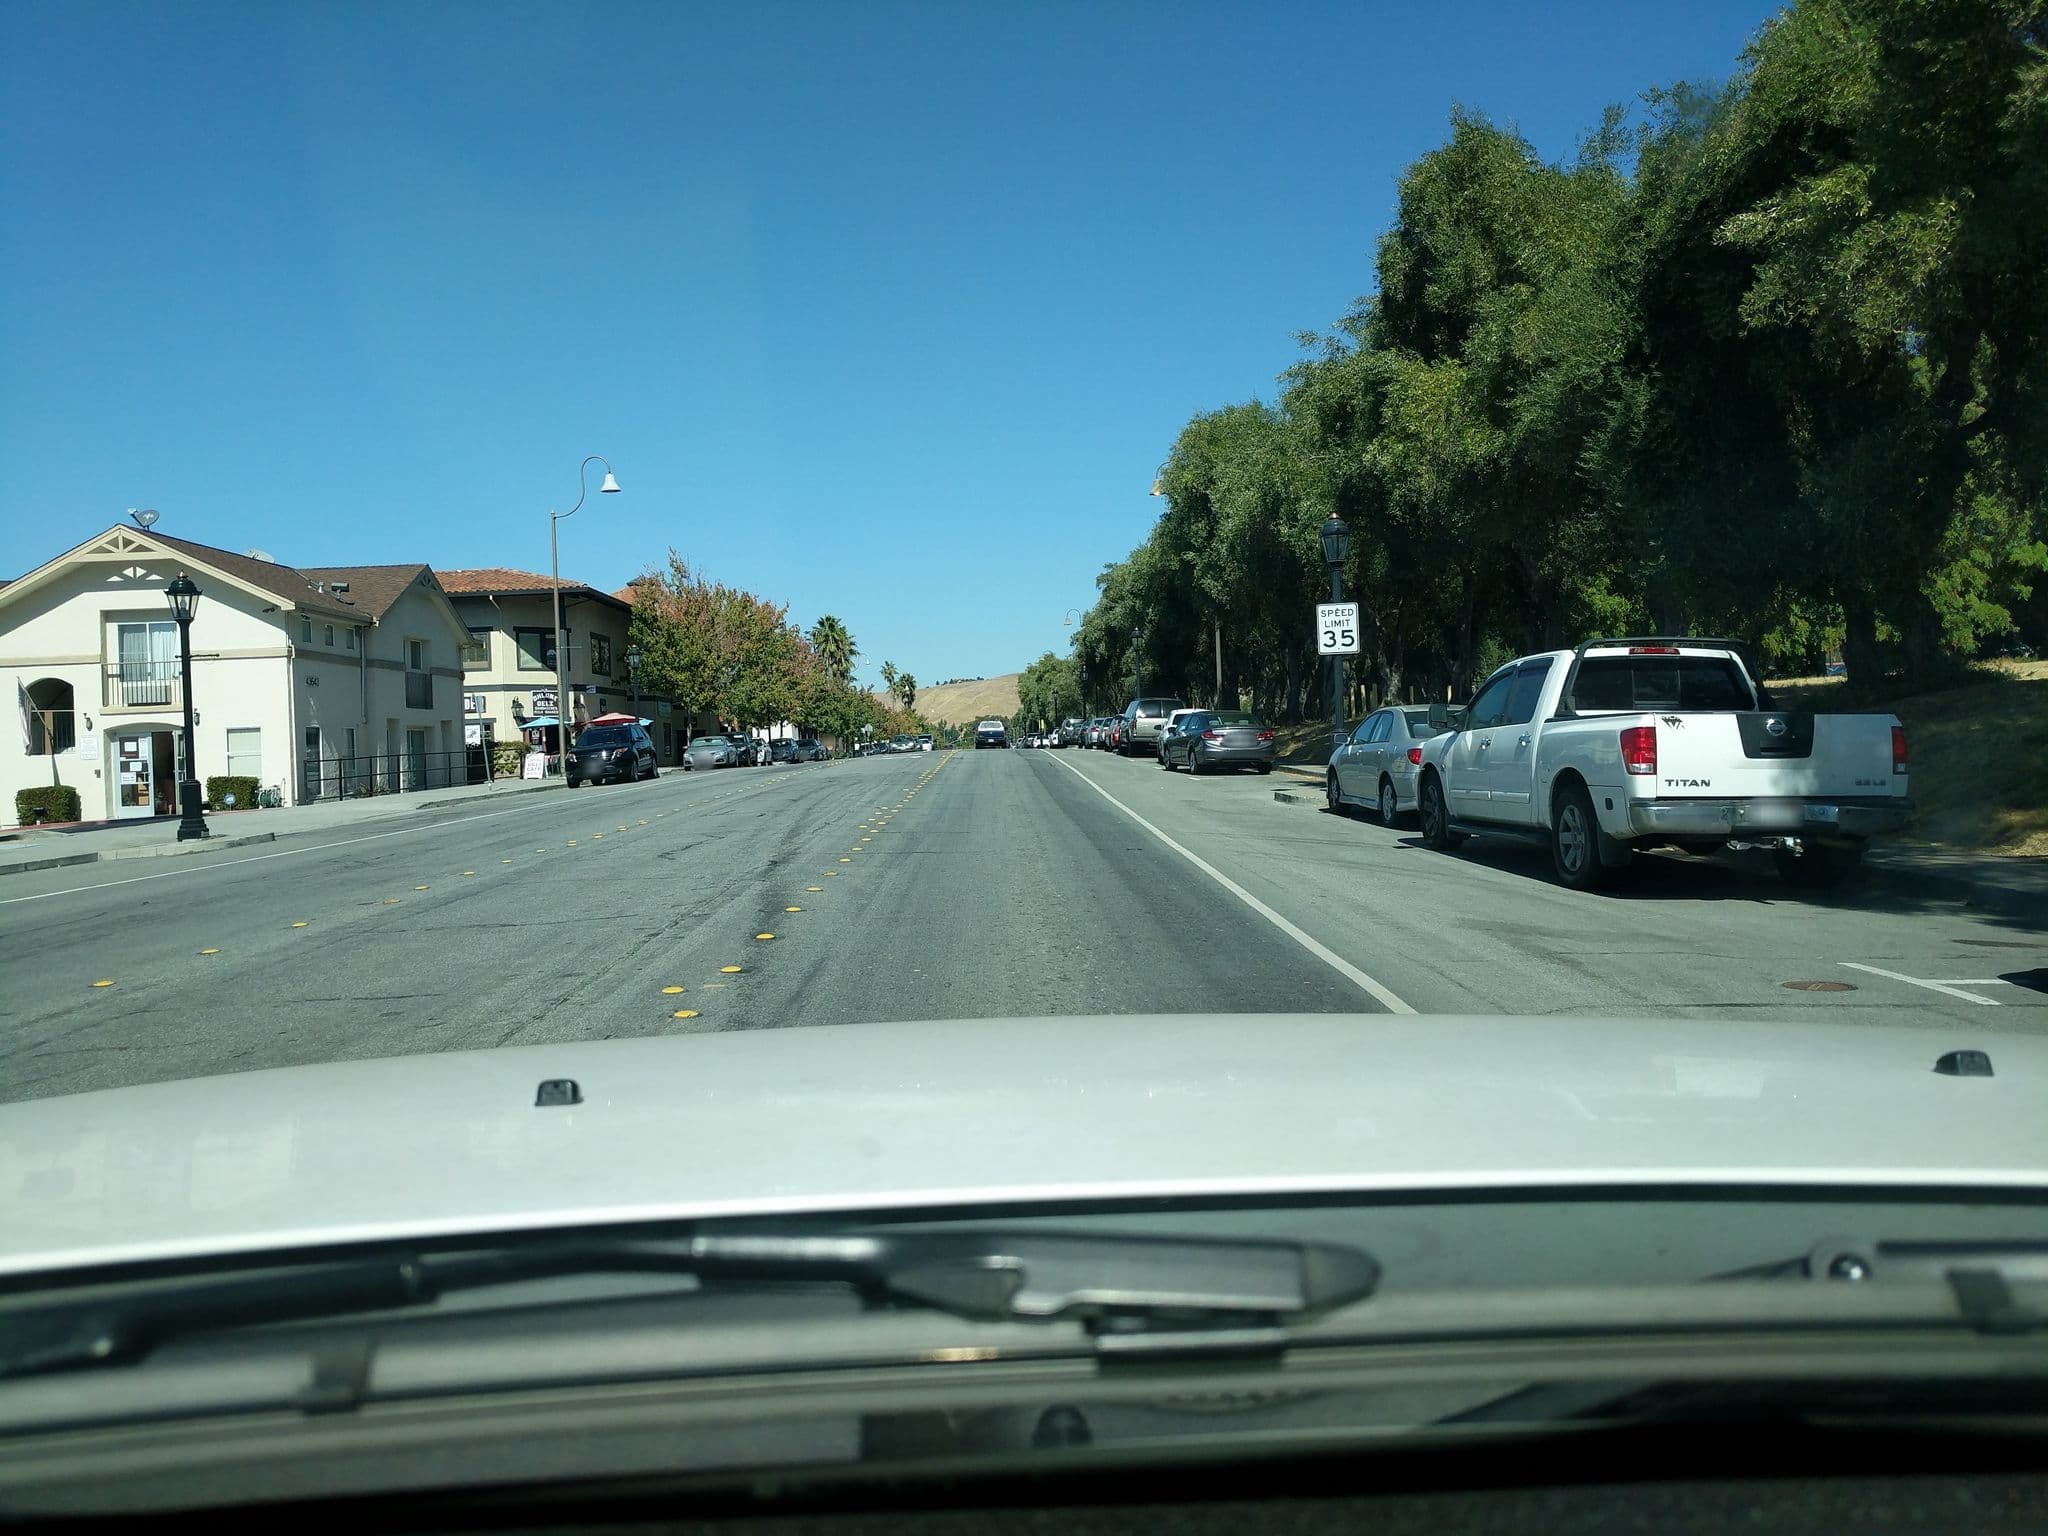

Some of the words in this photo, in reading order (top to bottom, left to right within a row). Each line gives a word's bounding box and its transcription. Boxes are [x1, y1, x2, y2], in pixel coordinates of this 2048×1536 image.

[1320, 608, 1354, 617] SPEED
[1324, 619, 1351, 628] LIMIT
[1323, 629, 1355, 648] 35
[1664, 779, 1711, 787] TITAN
